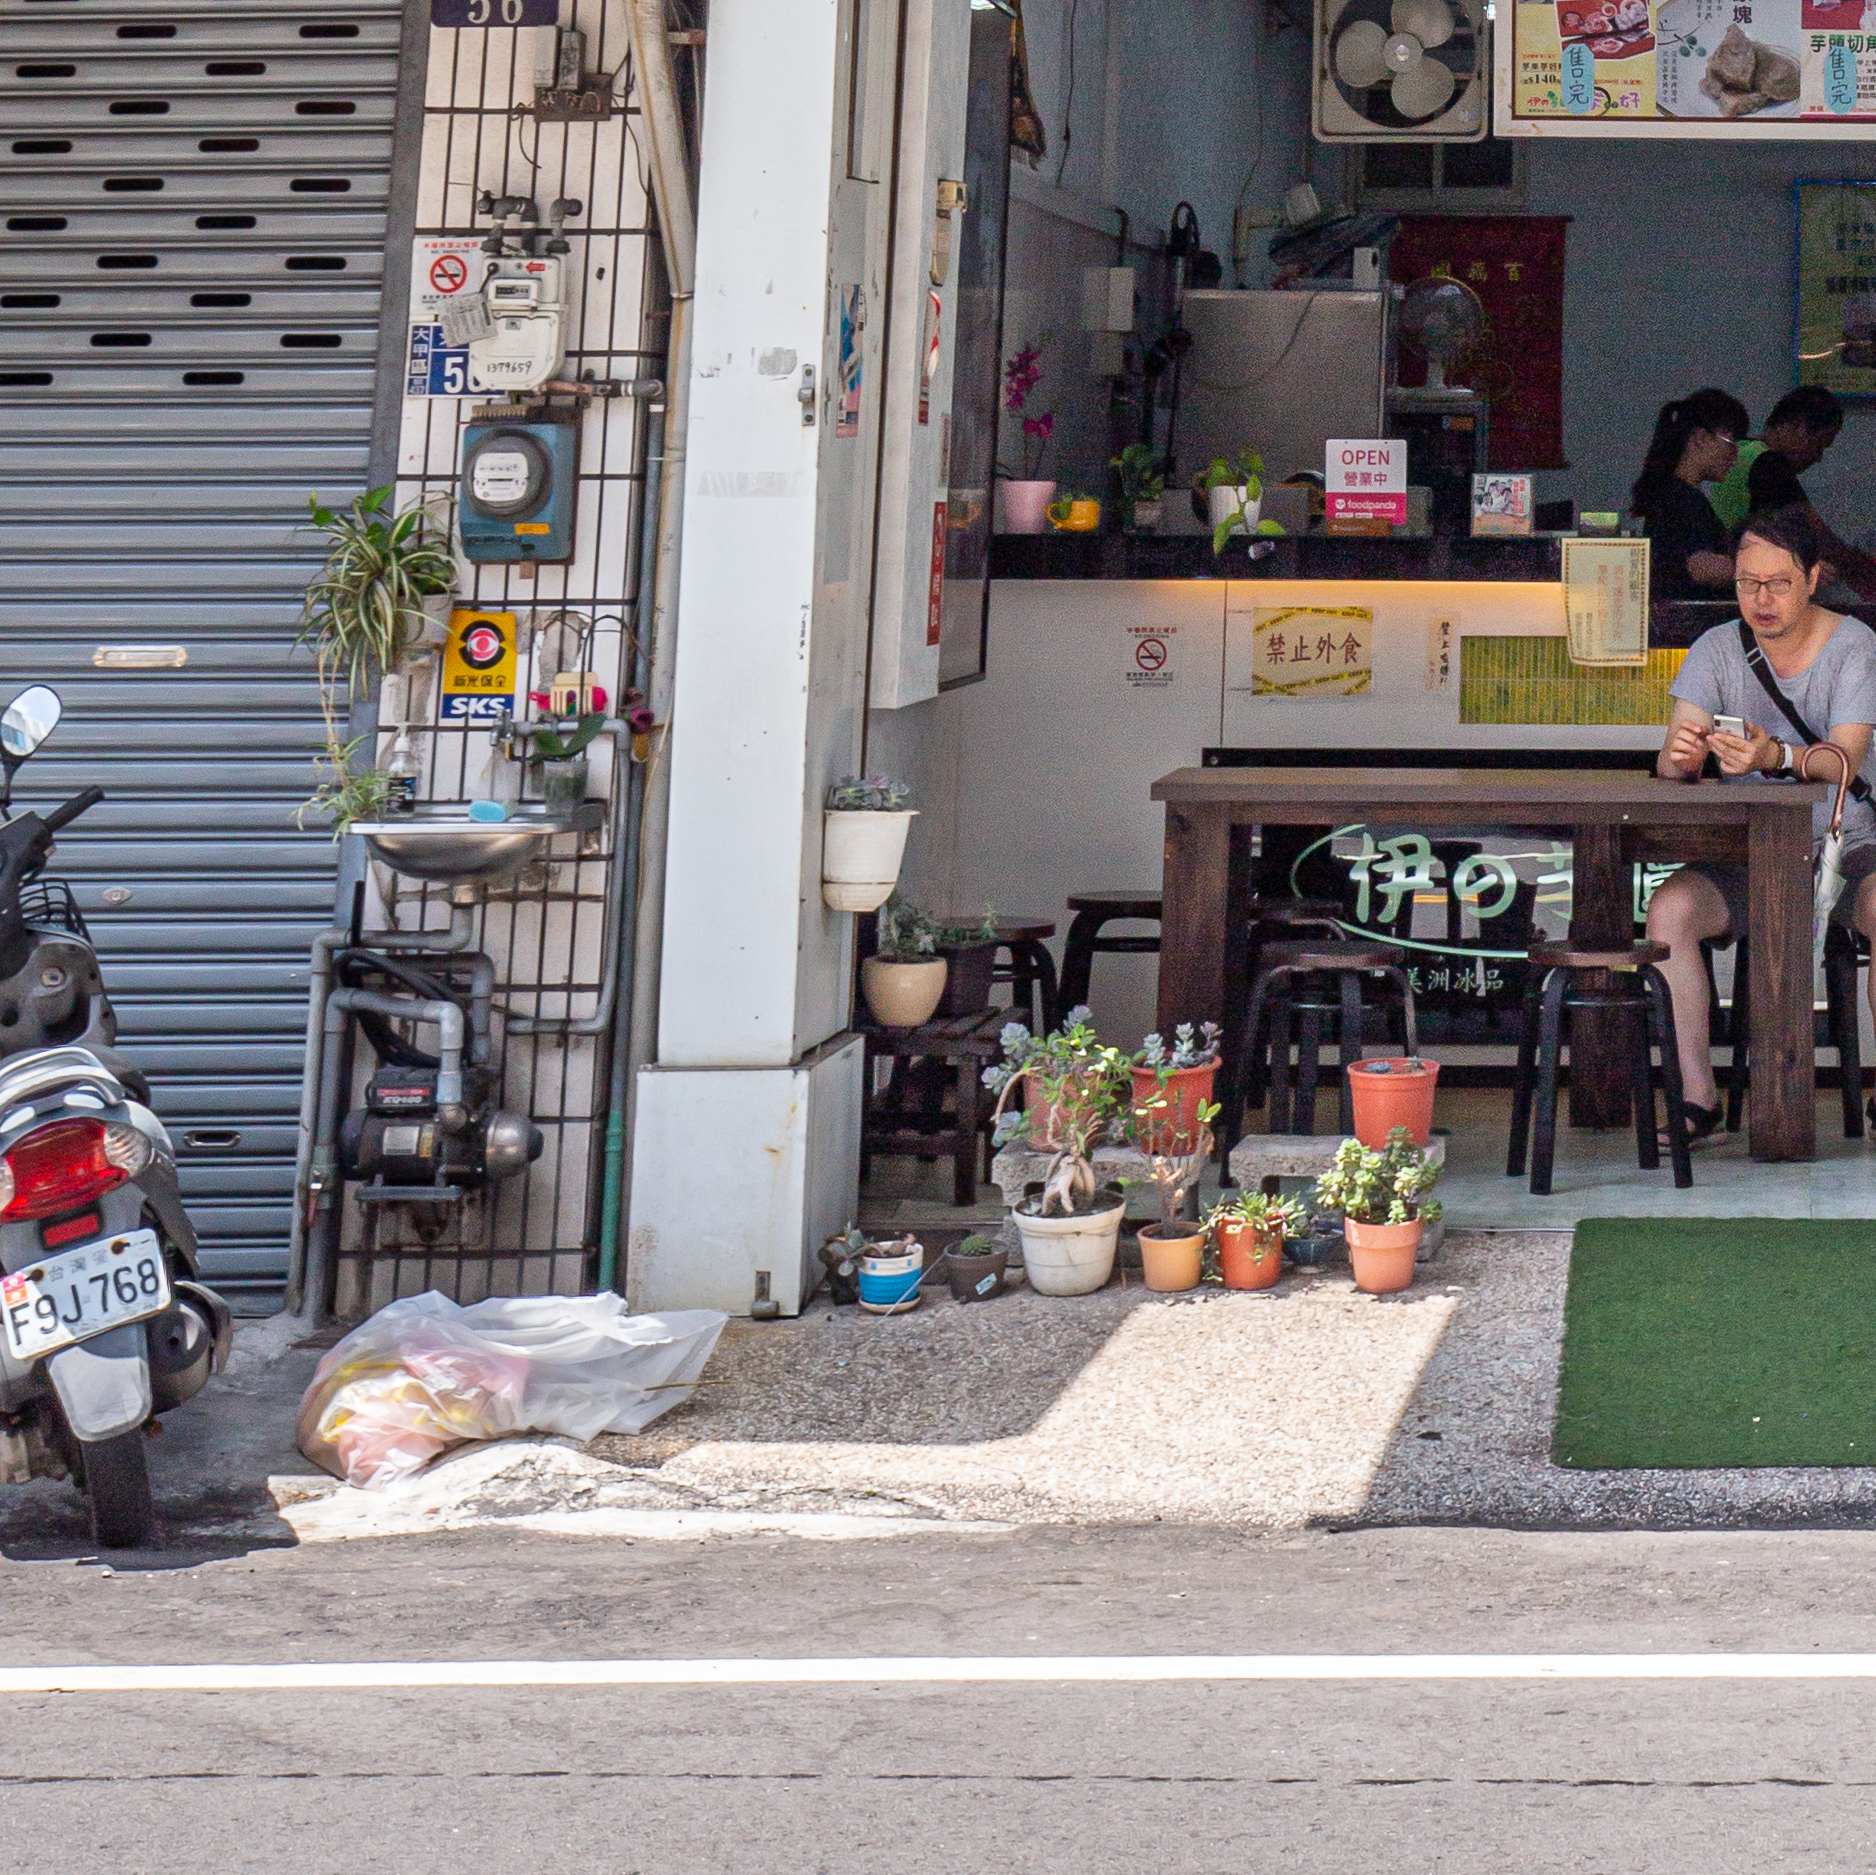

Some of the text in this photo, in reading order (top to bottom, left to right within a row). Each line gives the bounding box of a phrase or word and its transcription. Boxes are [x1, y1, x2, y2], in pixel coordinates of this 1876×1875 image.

[1567, 45, 1589, 105] 售完
[1829, 49, 1852, 106] 售完
[1342, 449, 1390, 466] OPEN
[1344, 471, 1387, 487] 營業中
[1347, 499, 1397, 511] foodpanda
[1266, 631, 1362, 665] 禁止外食
[453, 674, 508, 689] 新光保全
[450, 697, 504, 716] SKS
